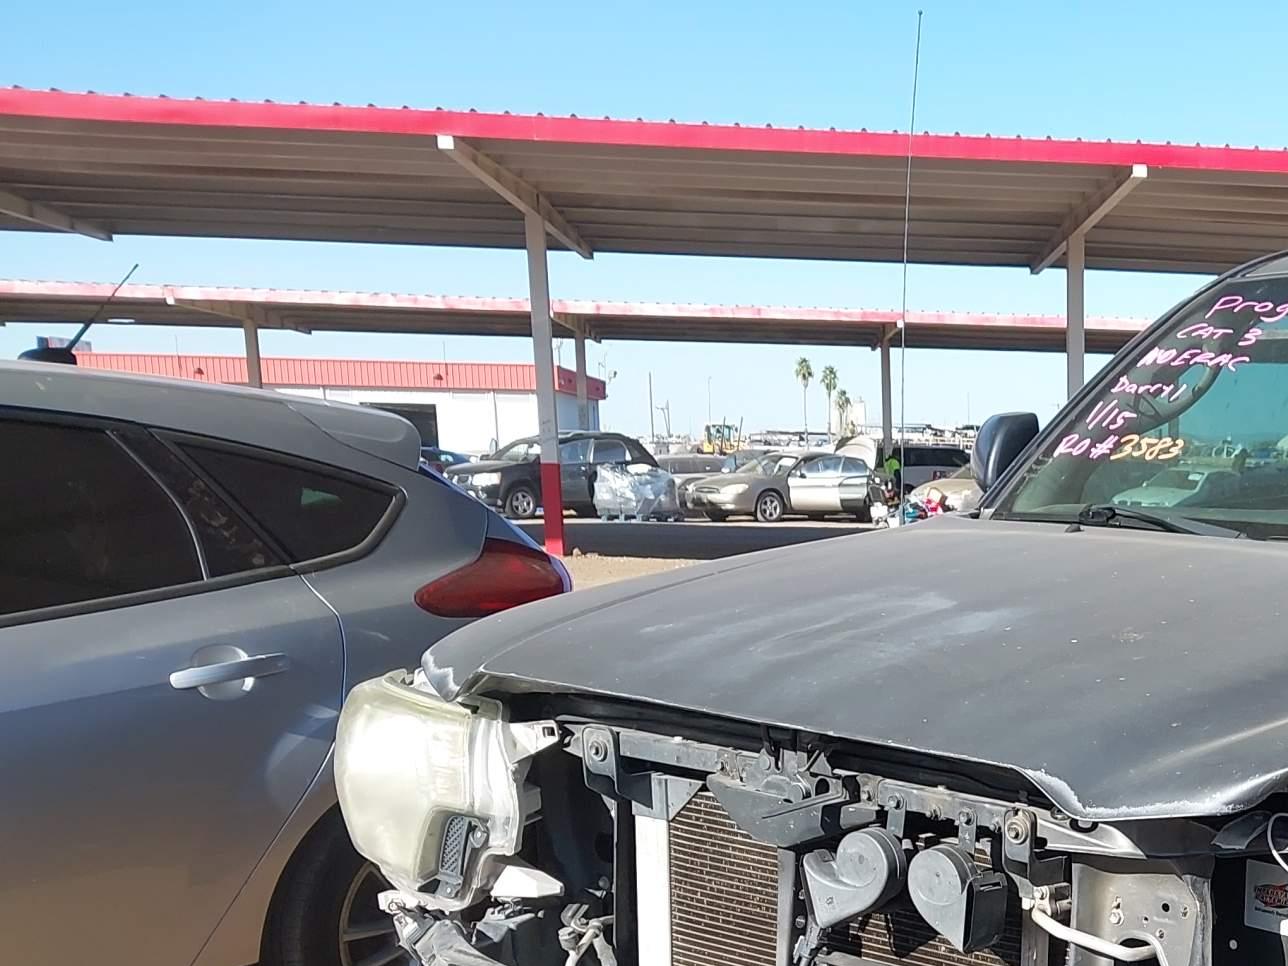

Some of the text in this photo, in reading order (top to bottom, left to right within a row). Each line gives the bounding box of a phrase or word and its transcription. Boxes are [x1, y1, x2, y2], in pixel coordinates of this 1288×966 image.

[1176, 323, 1263, 347] CAT 3
[1110, 375, 1188, 402] Darryl
[1086, 399, 1138, 430] 1/15
